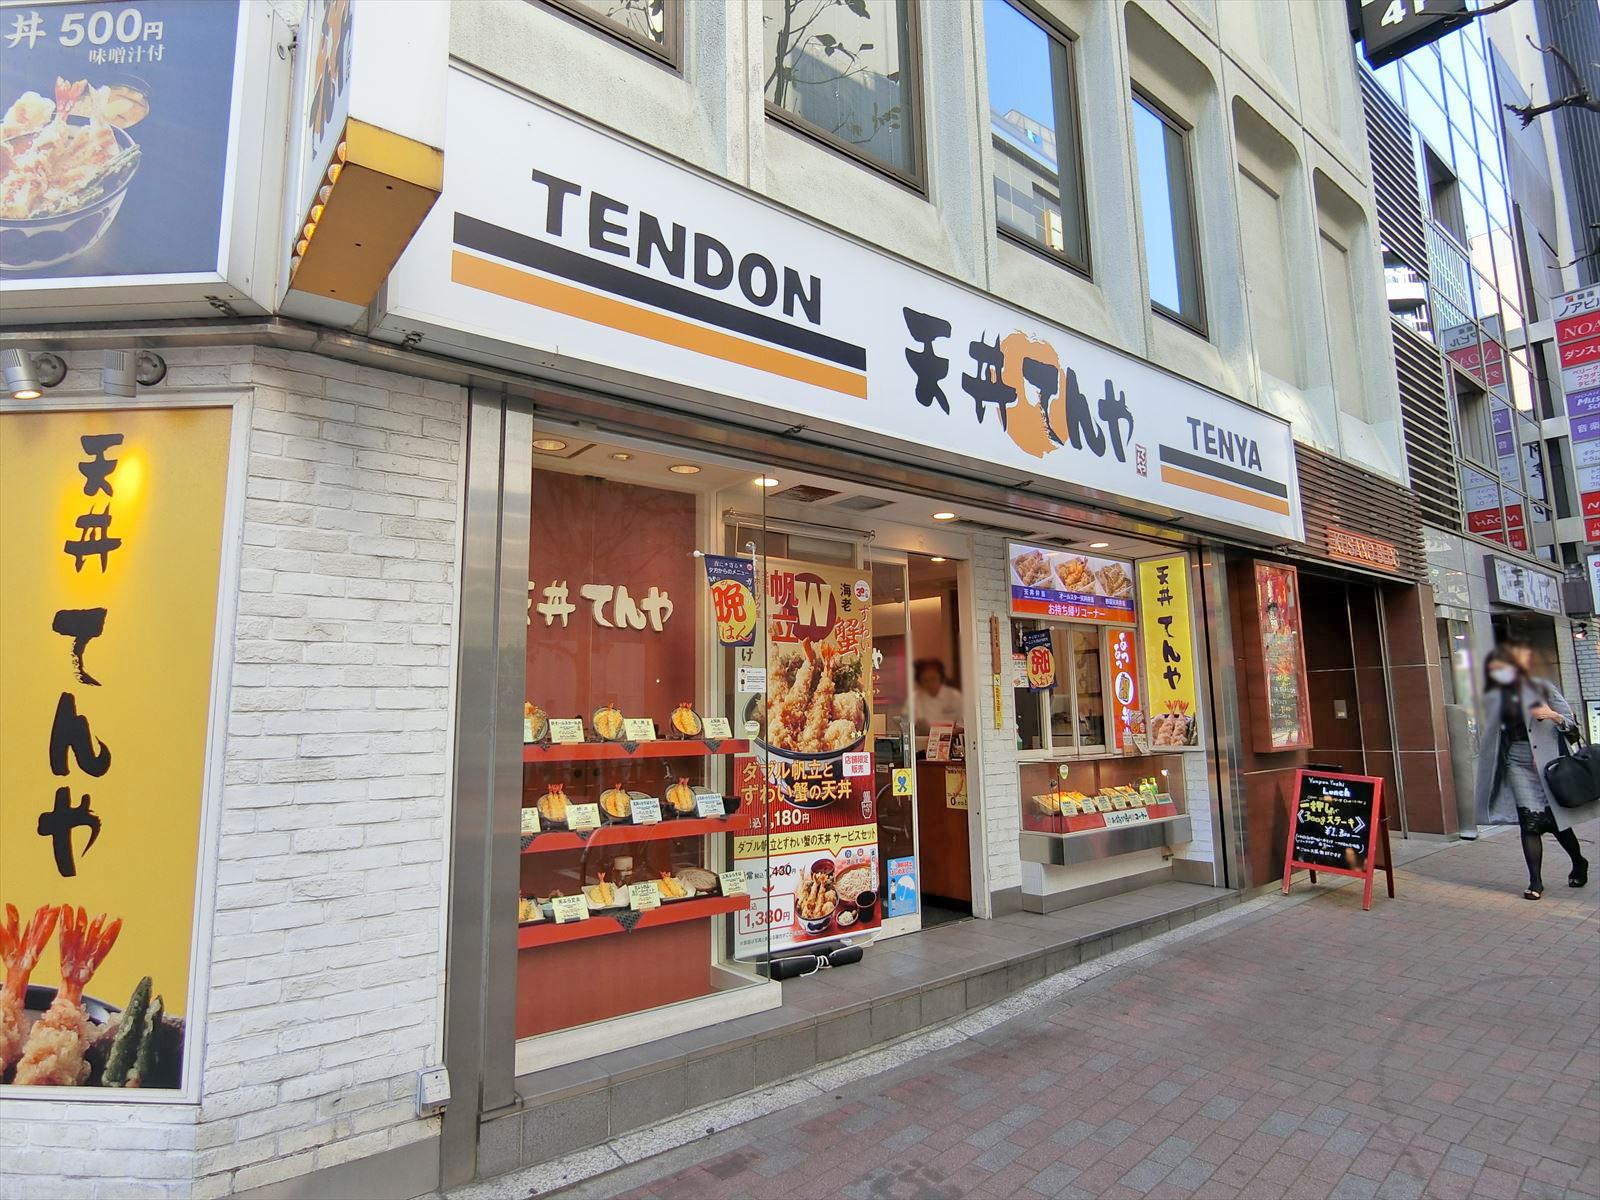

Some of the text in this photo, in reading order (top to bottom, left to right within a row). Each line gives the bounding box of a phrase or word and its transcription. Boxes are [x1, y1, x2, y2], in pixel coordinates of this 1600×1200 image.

[5, 8, 164, 49] 丼 500円
[89, 44, 165, 66] 味噌汁付
[531, 168, 821, 325] TENDON
[1186, 416, 1263, 472] TENYA
[711, 583, 747, 623] 晩
[770, 569, 800, 643] 帆立
[795, 580, 832, 627] W
[840, 583, 852, 612] 海老
[1048, 603, 1105, 618] お持ち帰りコーナー
[835, 617, 859, 656] 蟹
[743, 760, 833, 782] ダブル帆立と
[844, 755, 869, 765] 店舗限定
[851, 764, 864, 774] 販売
[741, 779, 852, 805] ずわい蟹の天丼
[1322, 787, 1351, 797] Lunch
[833, 829, 876, 842] サービスセット
[744, 908, 791, 929] 1,380円
